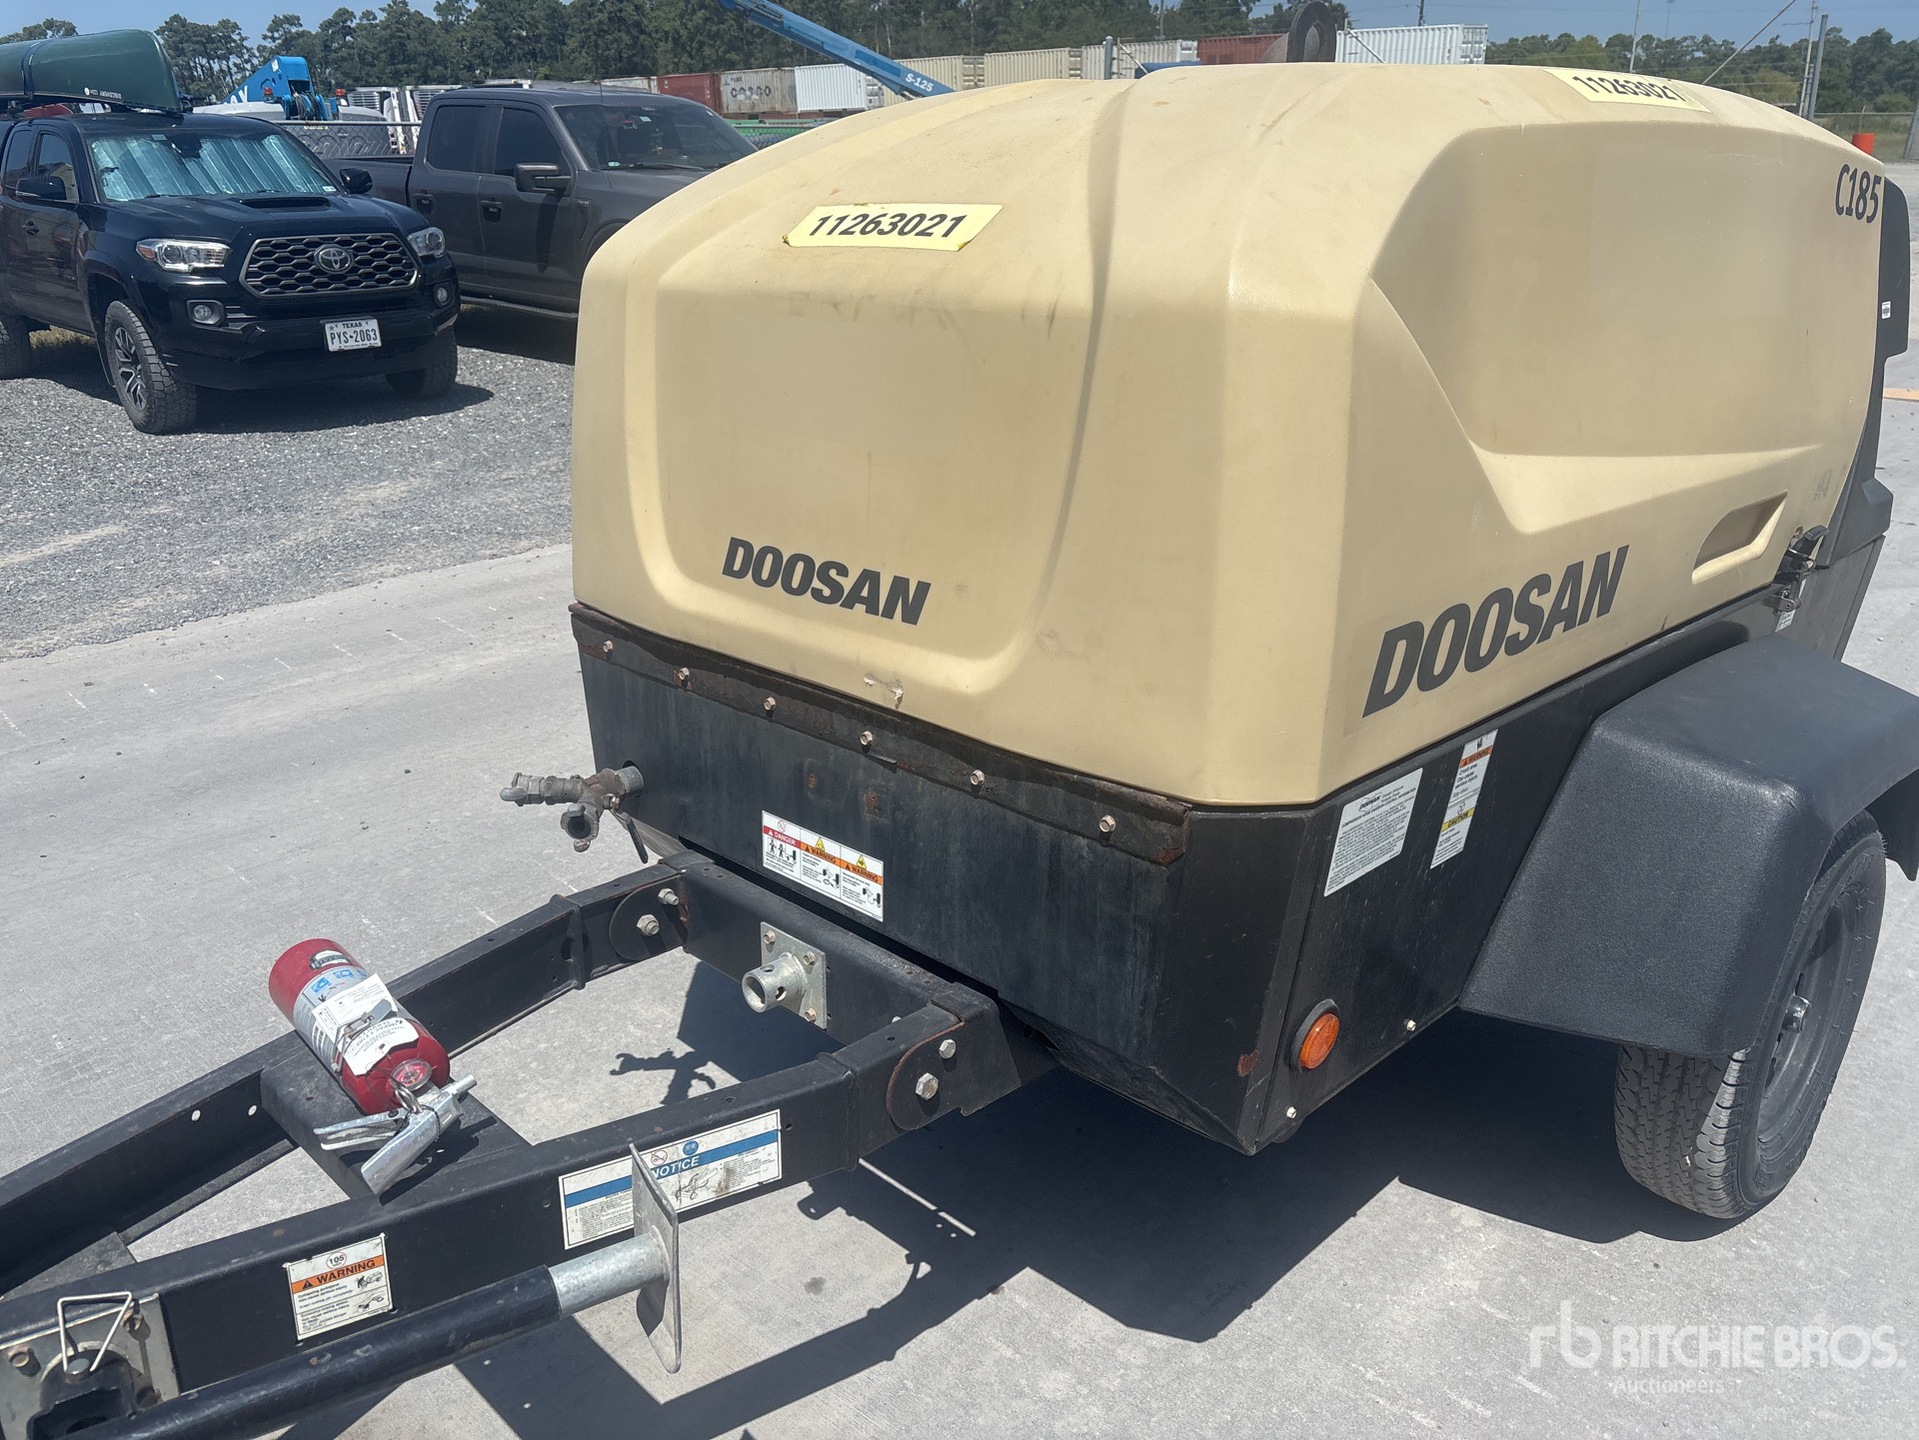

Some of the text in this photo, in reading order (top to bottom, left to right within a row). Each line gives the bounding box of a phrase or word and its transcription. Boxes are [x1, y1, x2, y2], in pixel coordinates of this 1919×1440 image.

[905, 73, 934, 92] S-125
[1572, 76, 1687, 102] 11263021
[1835, 163, 1882, 224] C185
[809, 212, 968, 238] 11263021
[342, 321, 363, 329] TEXAS
[722, 536, 932, 626] DOOSAN
[1361, 544, 1630, 719] DOOSAN
[651, 1155, 700, 1178] NOTICE
[316, 1259, 376, 1284] WARNING
[328, 1254, 345, 1265] 105
